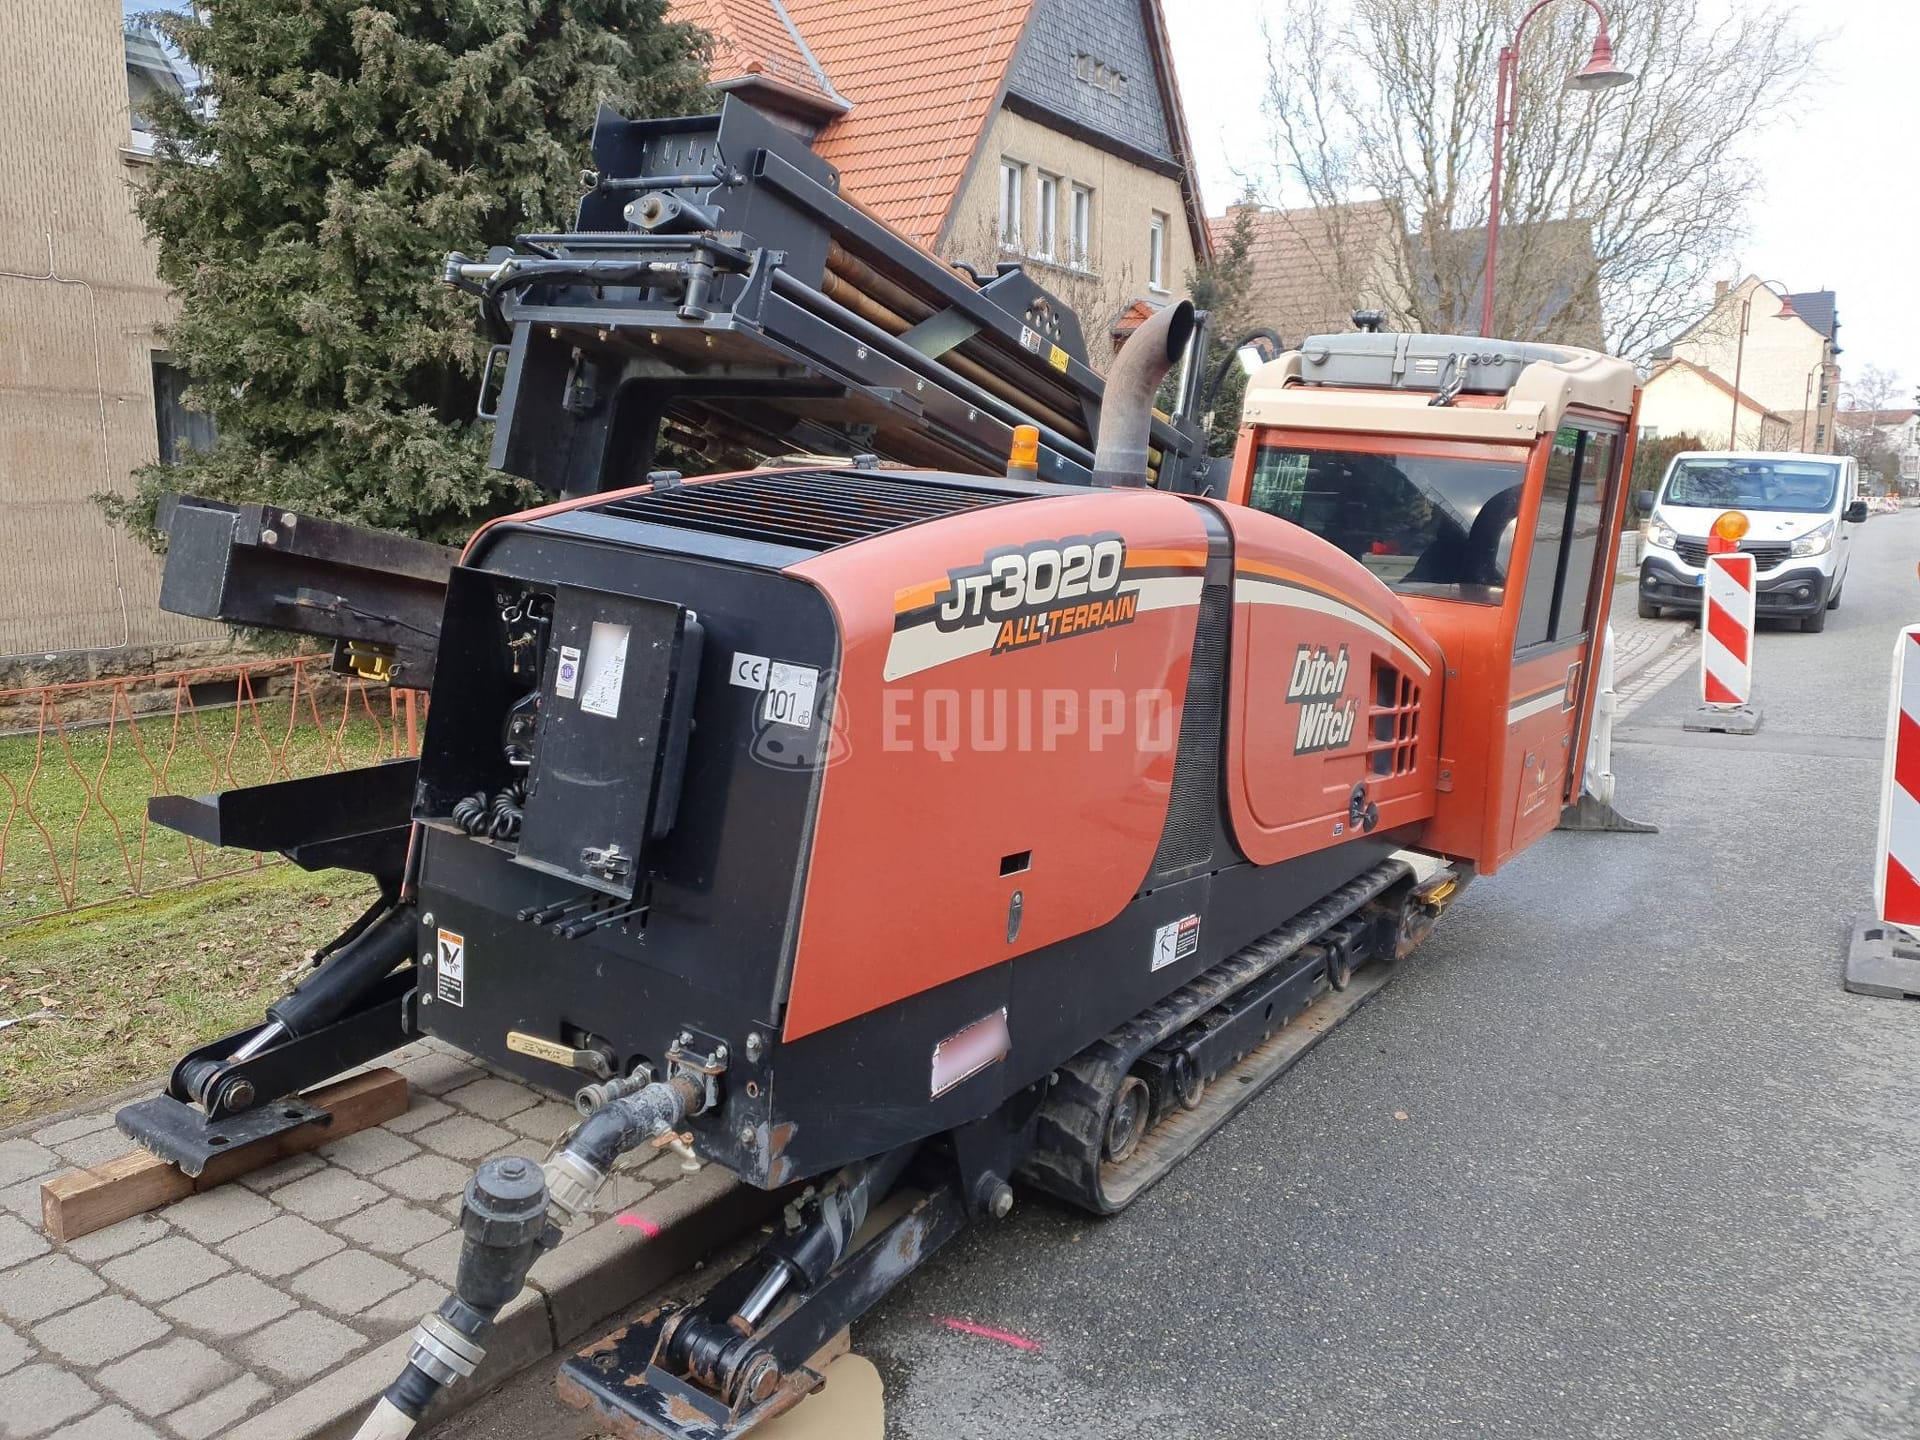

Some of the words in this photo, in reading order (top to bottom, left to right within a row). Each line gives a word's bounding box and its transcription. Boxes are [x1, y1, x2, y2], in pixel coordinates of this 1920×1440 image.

[941, 540, 1122, 621] JT3020
[996, 614, 1040, 648] ALL
[1048, 595, 1137, 637] TERRAIN
[738, 660, 762, 683] CE
[1289, 649, 1348, 697] Ditch
[769, 688, 796, 722] 101
[1296, 700, 1355, 749] Witch
